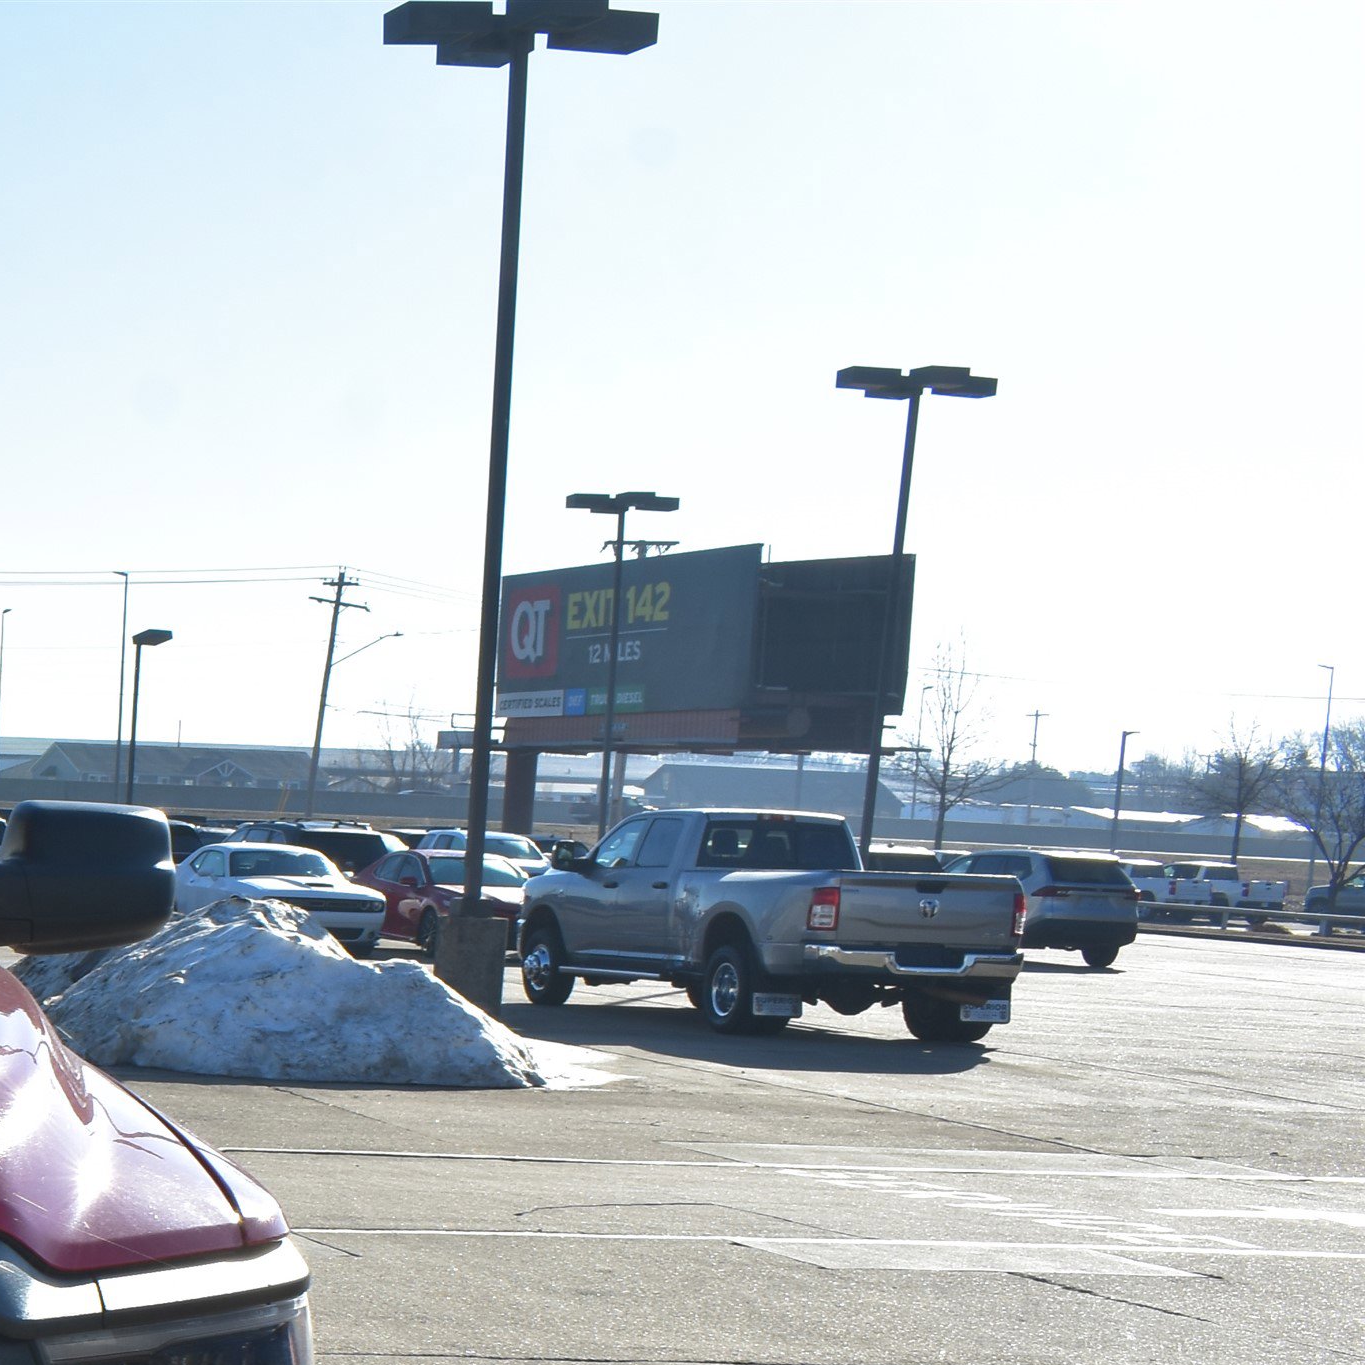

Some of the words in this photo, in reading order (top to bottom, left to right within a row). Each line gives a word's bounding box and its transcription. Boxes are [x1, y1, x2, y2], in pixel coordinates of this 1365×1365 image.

[567, 589, 615, 630] EXIT
[626, 582, 671, 624] 142
[511, 599, 550, 663] QT
[588, 644, 601, 664] 12
[603, 640, 642, 664] MLES
[499, 698, 533, 711] CERTIFIED
[534, 696, 562, 708] SCALES
[615, 691, 643, 704] DIESEL
